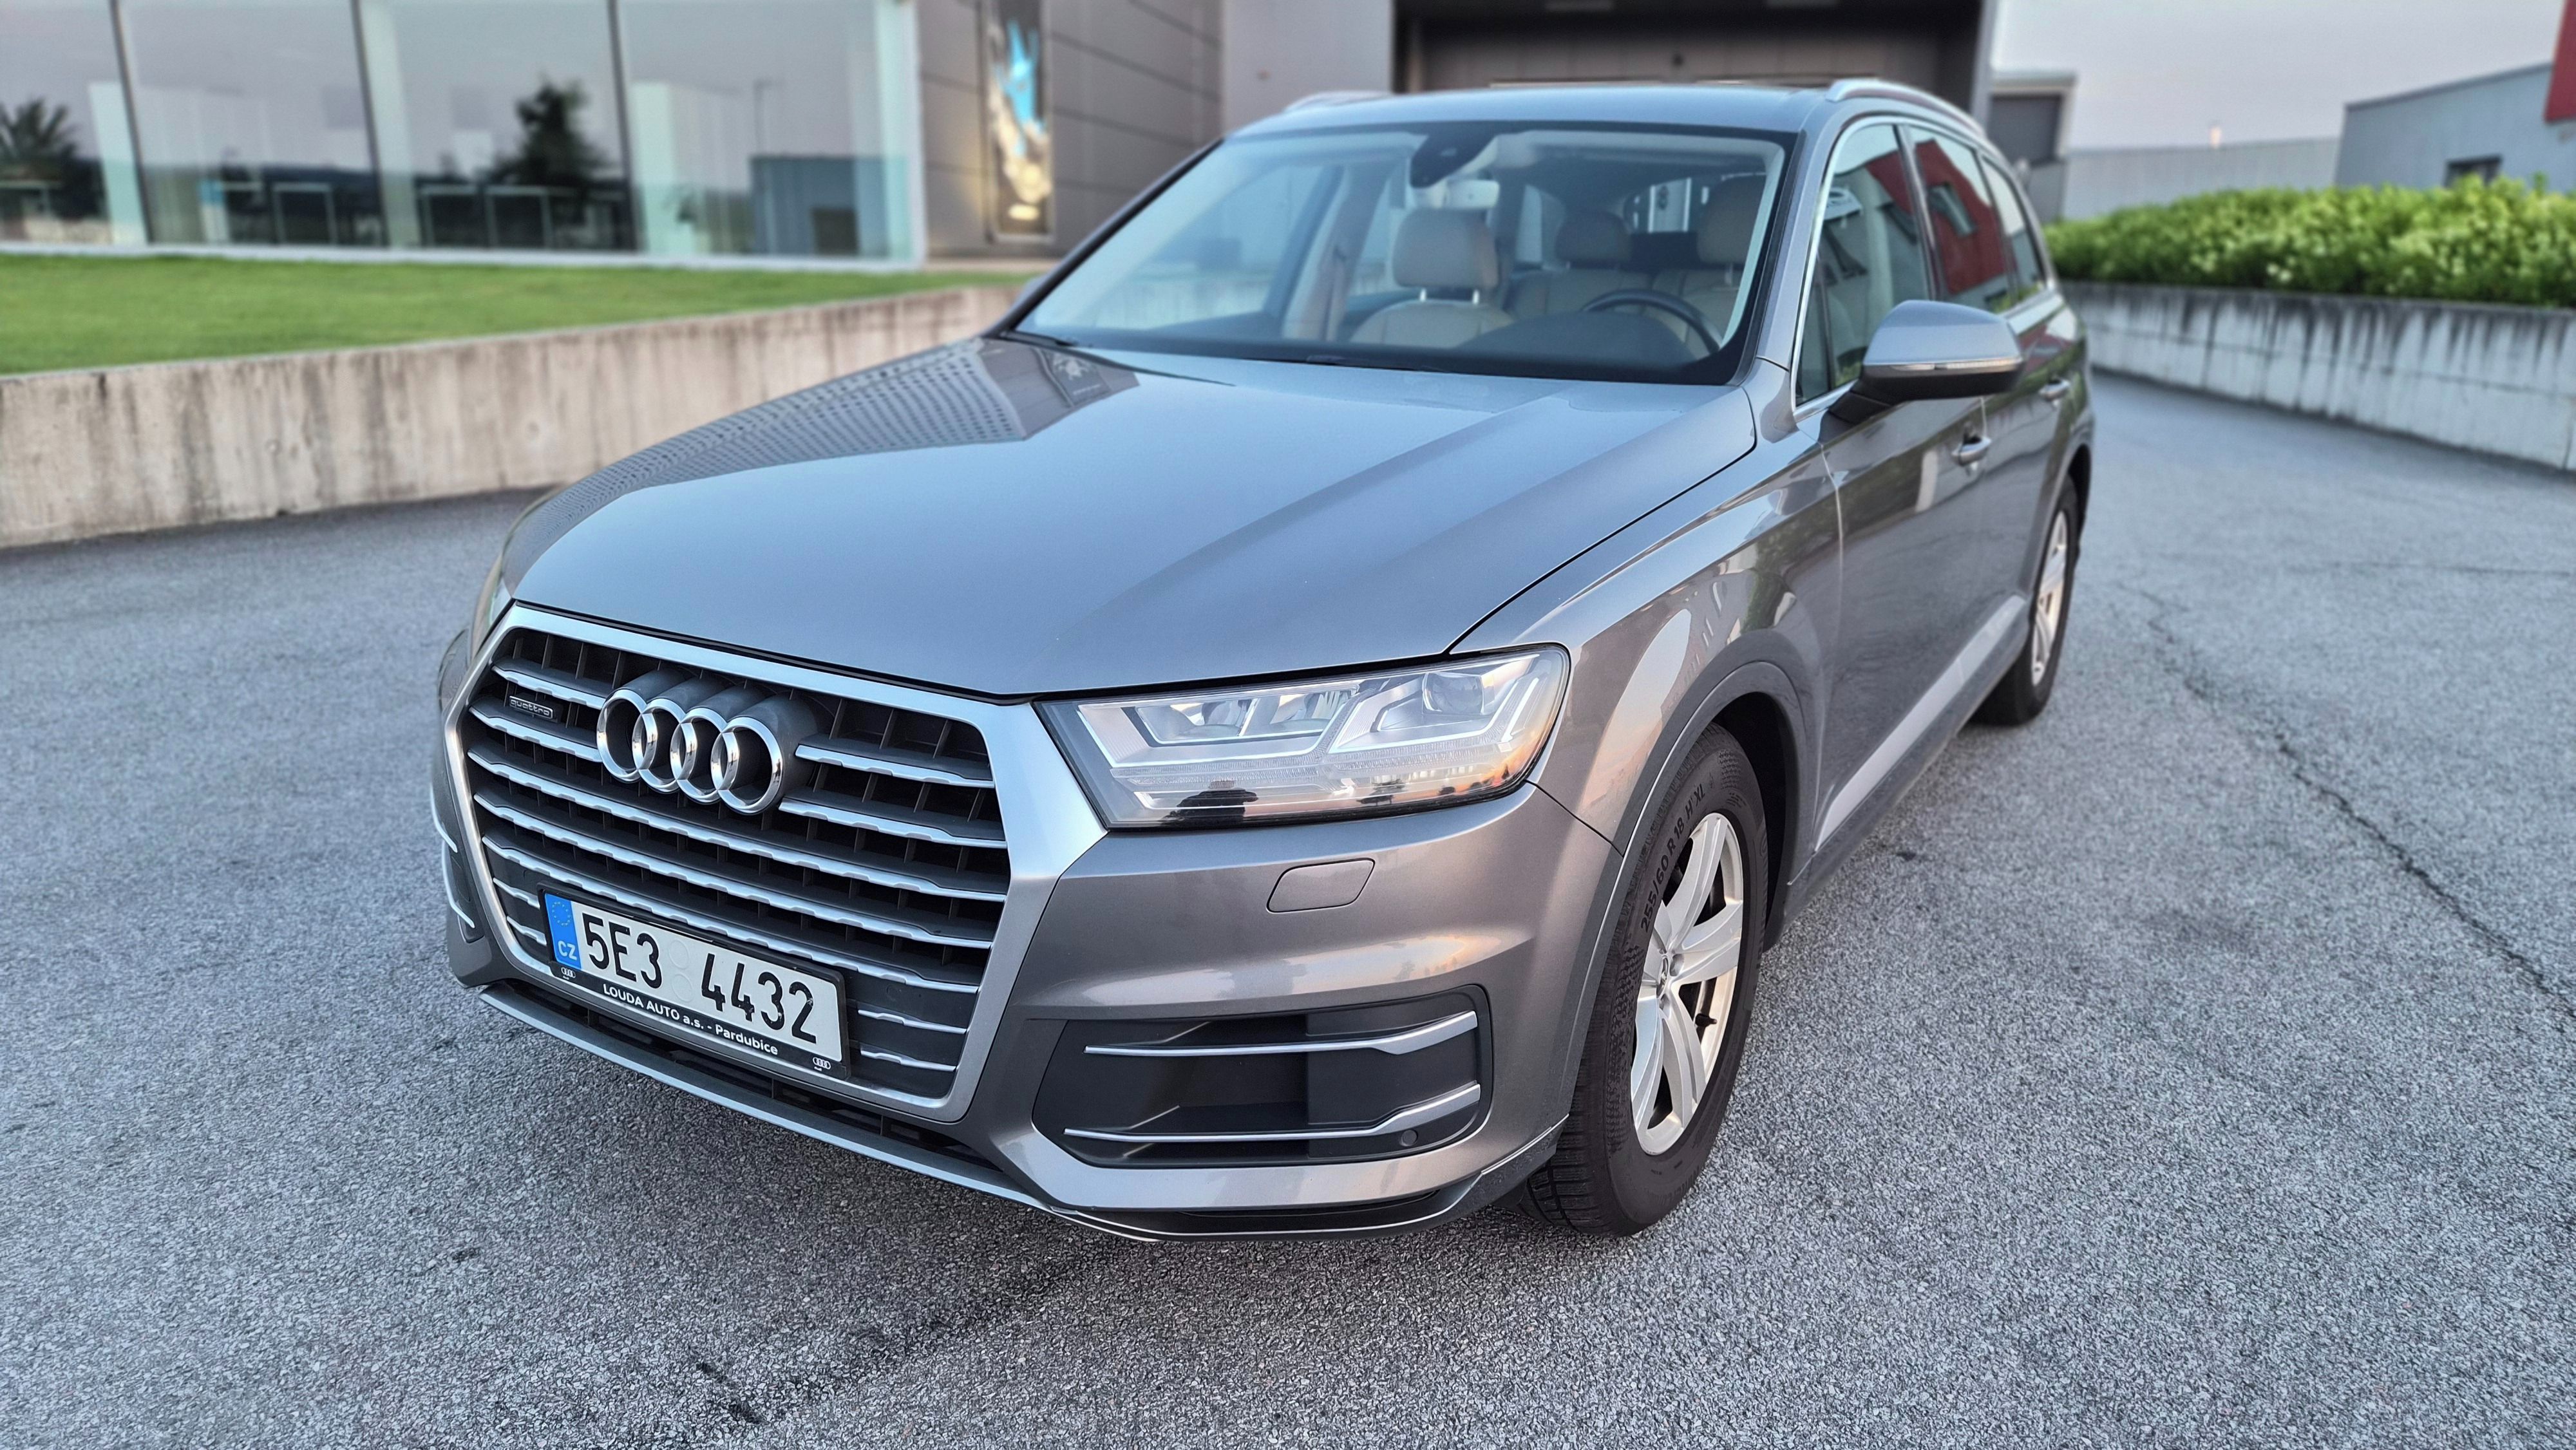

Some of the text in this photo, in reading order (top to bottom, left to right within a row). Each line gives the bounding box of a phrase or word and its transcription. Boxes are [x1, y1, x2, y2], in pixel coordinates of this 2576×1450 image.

[511, 699, 550, 716] quattro
[1641, 855, 1669, 933] 255/60
[1667, 838, 1676, 856] R
[1674, 817, 1684, 840] 18
[558, 941, 577, 961] CZ
[582, 912, 817, 1044] 5E3 4432
[603, 984, 644, 1008] LOUDA
[647, 1001, 680, 1021] AUTO
[683, 1014, 704, 1030] a.s.
[715, 1024, 778, 1055] Pardubice
